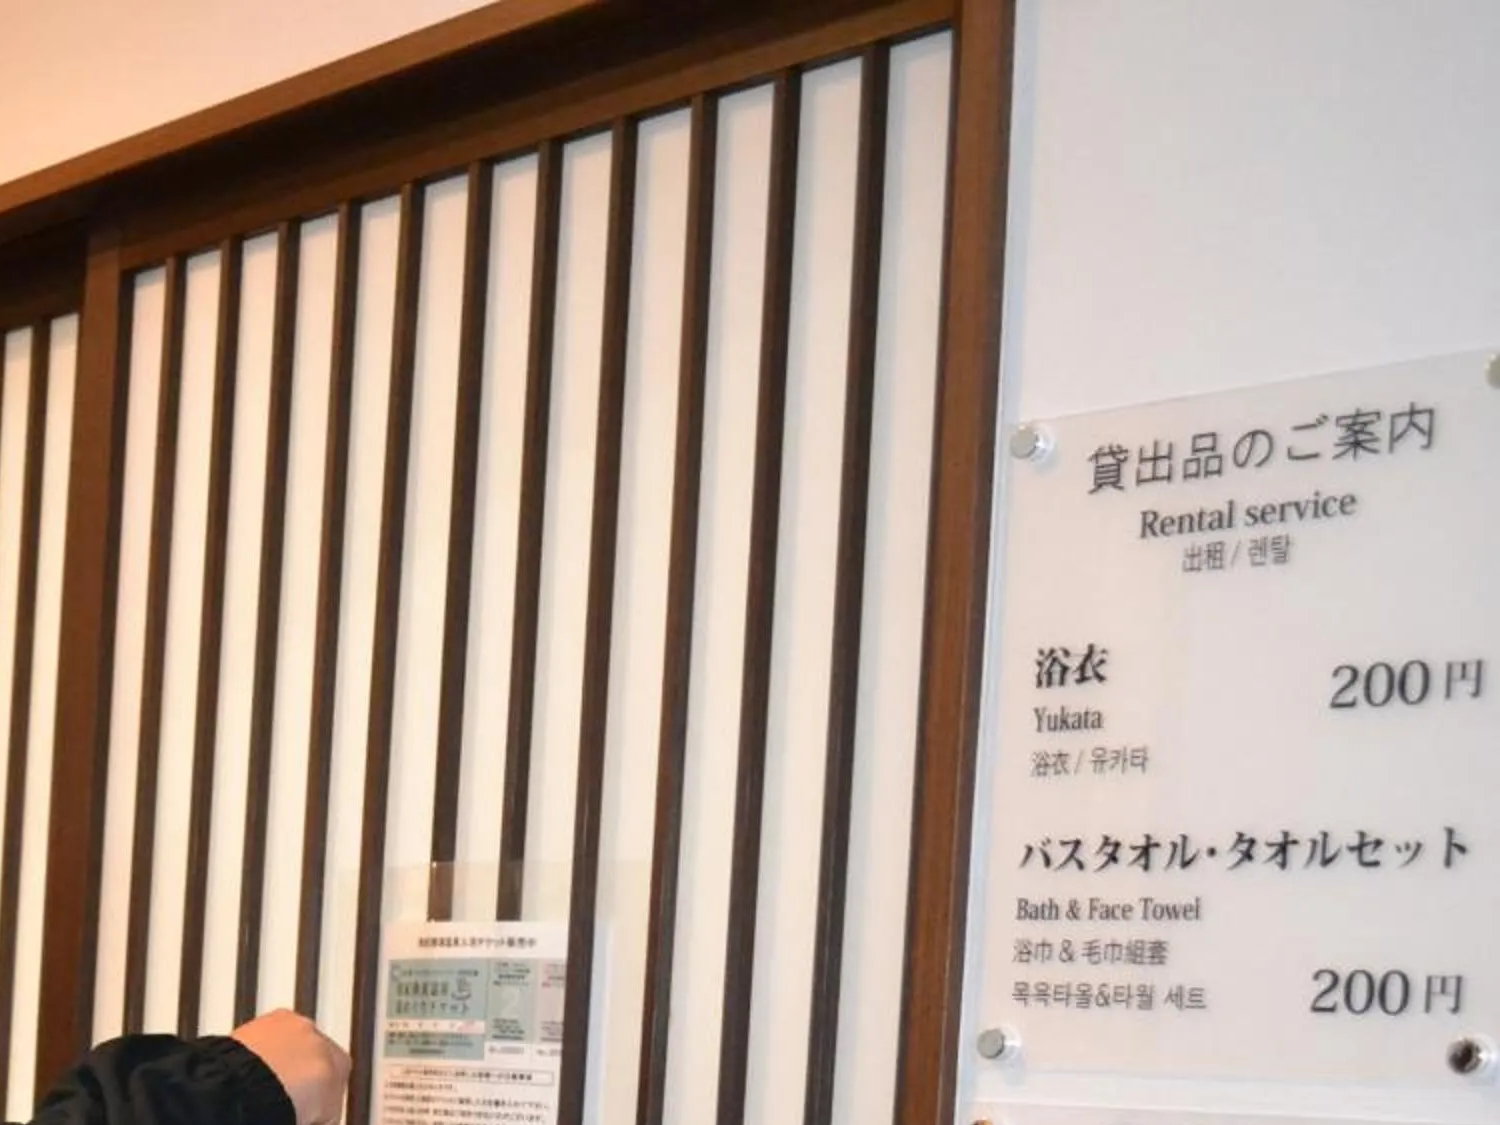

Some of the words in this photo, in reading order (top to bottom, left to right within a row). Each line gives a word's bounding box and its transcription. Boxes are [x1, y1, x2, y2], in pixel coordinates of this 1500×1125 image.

[1087, 401, 1437, 495] 貸出品のご案内
[1139, 500, 1234, 539] Rental
[1244, 491, 1357, 526] service
[1183, 540, 1225, 572] 出租
[1247, 534, 1292, 567] 렌탈
[1035, 643, 1109, 689] 浴衣
[1033, 705, 1104, 733] Yukata
[1030, 750, 1070, 777] 浴衣
[1090, 745, 1150, 775] 유카타
[1019, 827, 1470, 874] バスタオル・タオルセット
[1015, 897, 1059, 921] Bath
[1065, 898, 1081, 921] &
[1088, 897, 1134, 921] Face
[1139, 896, 1202, 921] Towel
[1058, 938, 1075, 963] &
[1164, 984, 1208, 1011] 세트
